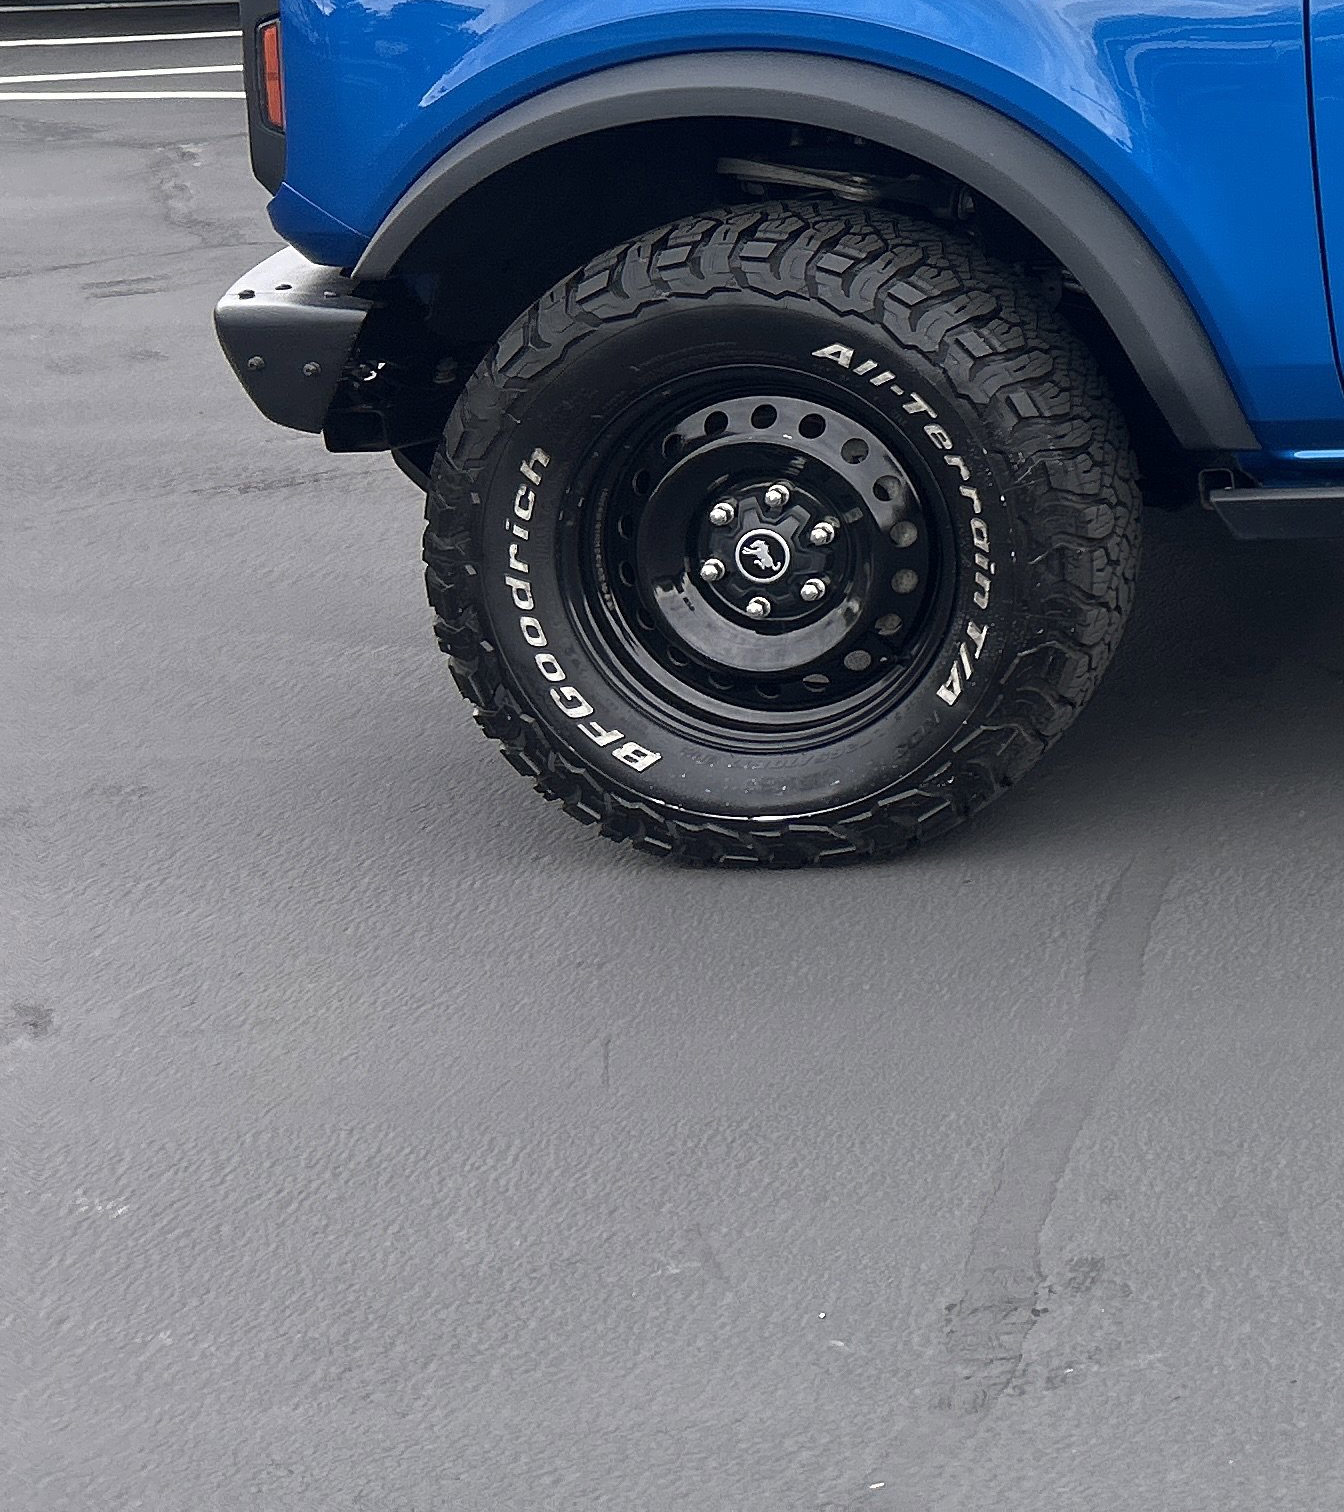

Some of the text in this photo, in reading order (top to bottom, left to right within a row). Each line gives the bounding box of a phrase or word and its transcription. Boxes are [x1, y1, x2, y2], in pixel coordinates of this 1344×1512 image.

[504, 448, 662, 772] BFGoodrich
[811, 343, 993, 606] All-Terrain
[935, 621, 990, 706] T/A
